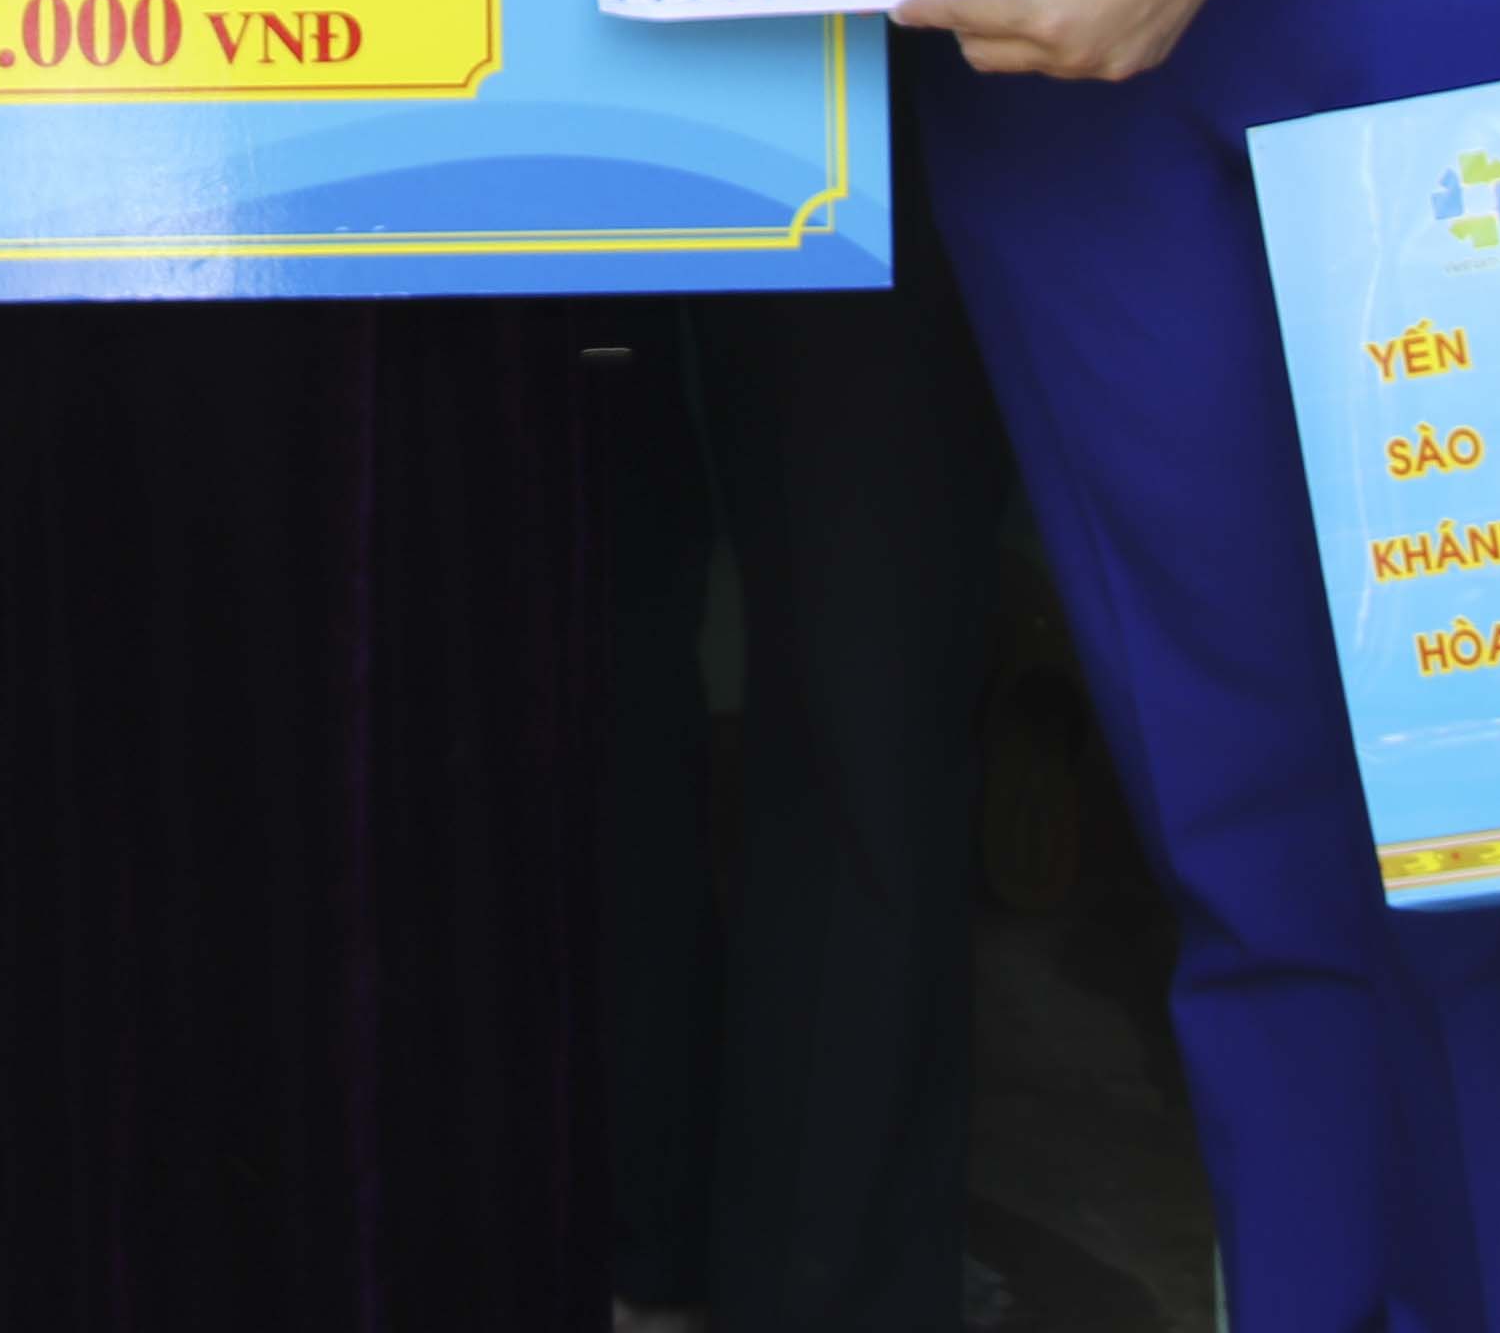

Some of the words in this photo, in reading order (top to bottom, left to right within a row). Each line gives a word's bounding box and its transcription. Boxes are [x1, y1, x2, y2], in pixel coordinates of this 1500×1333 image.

[204, 9, 363, 66] VNĐ
[1364, 318, 1472, 383] YẾN
[1385, 420, 1484, 480] SÀO
